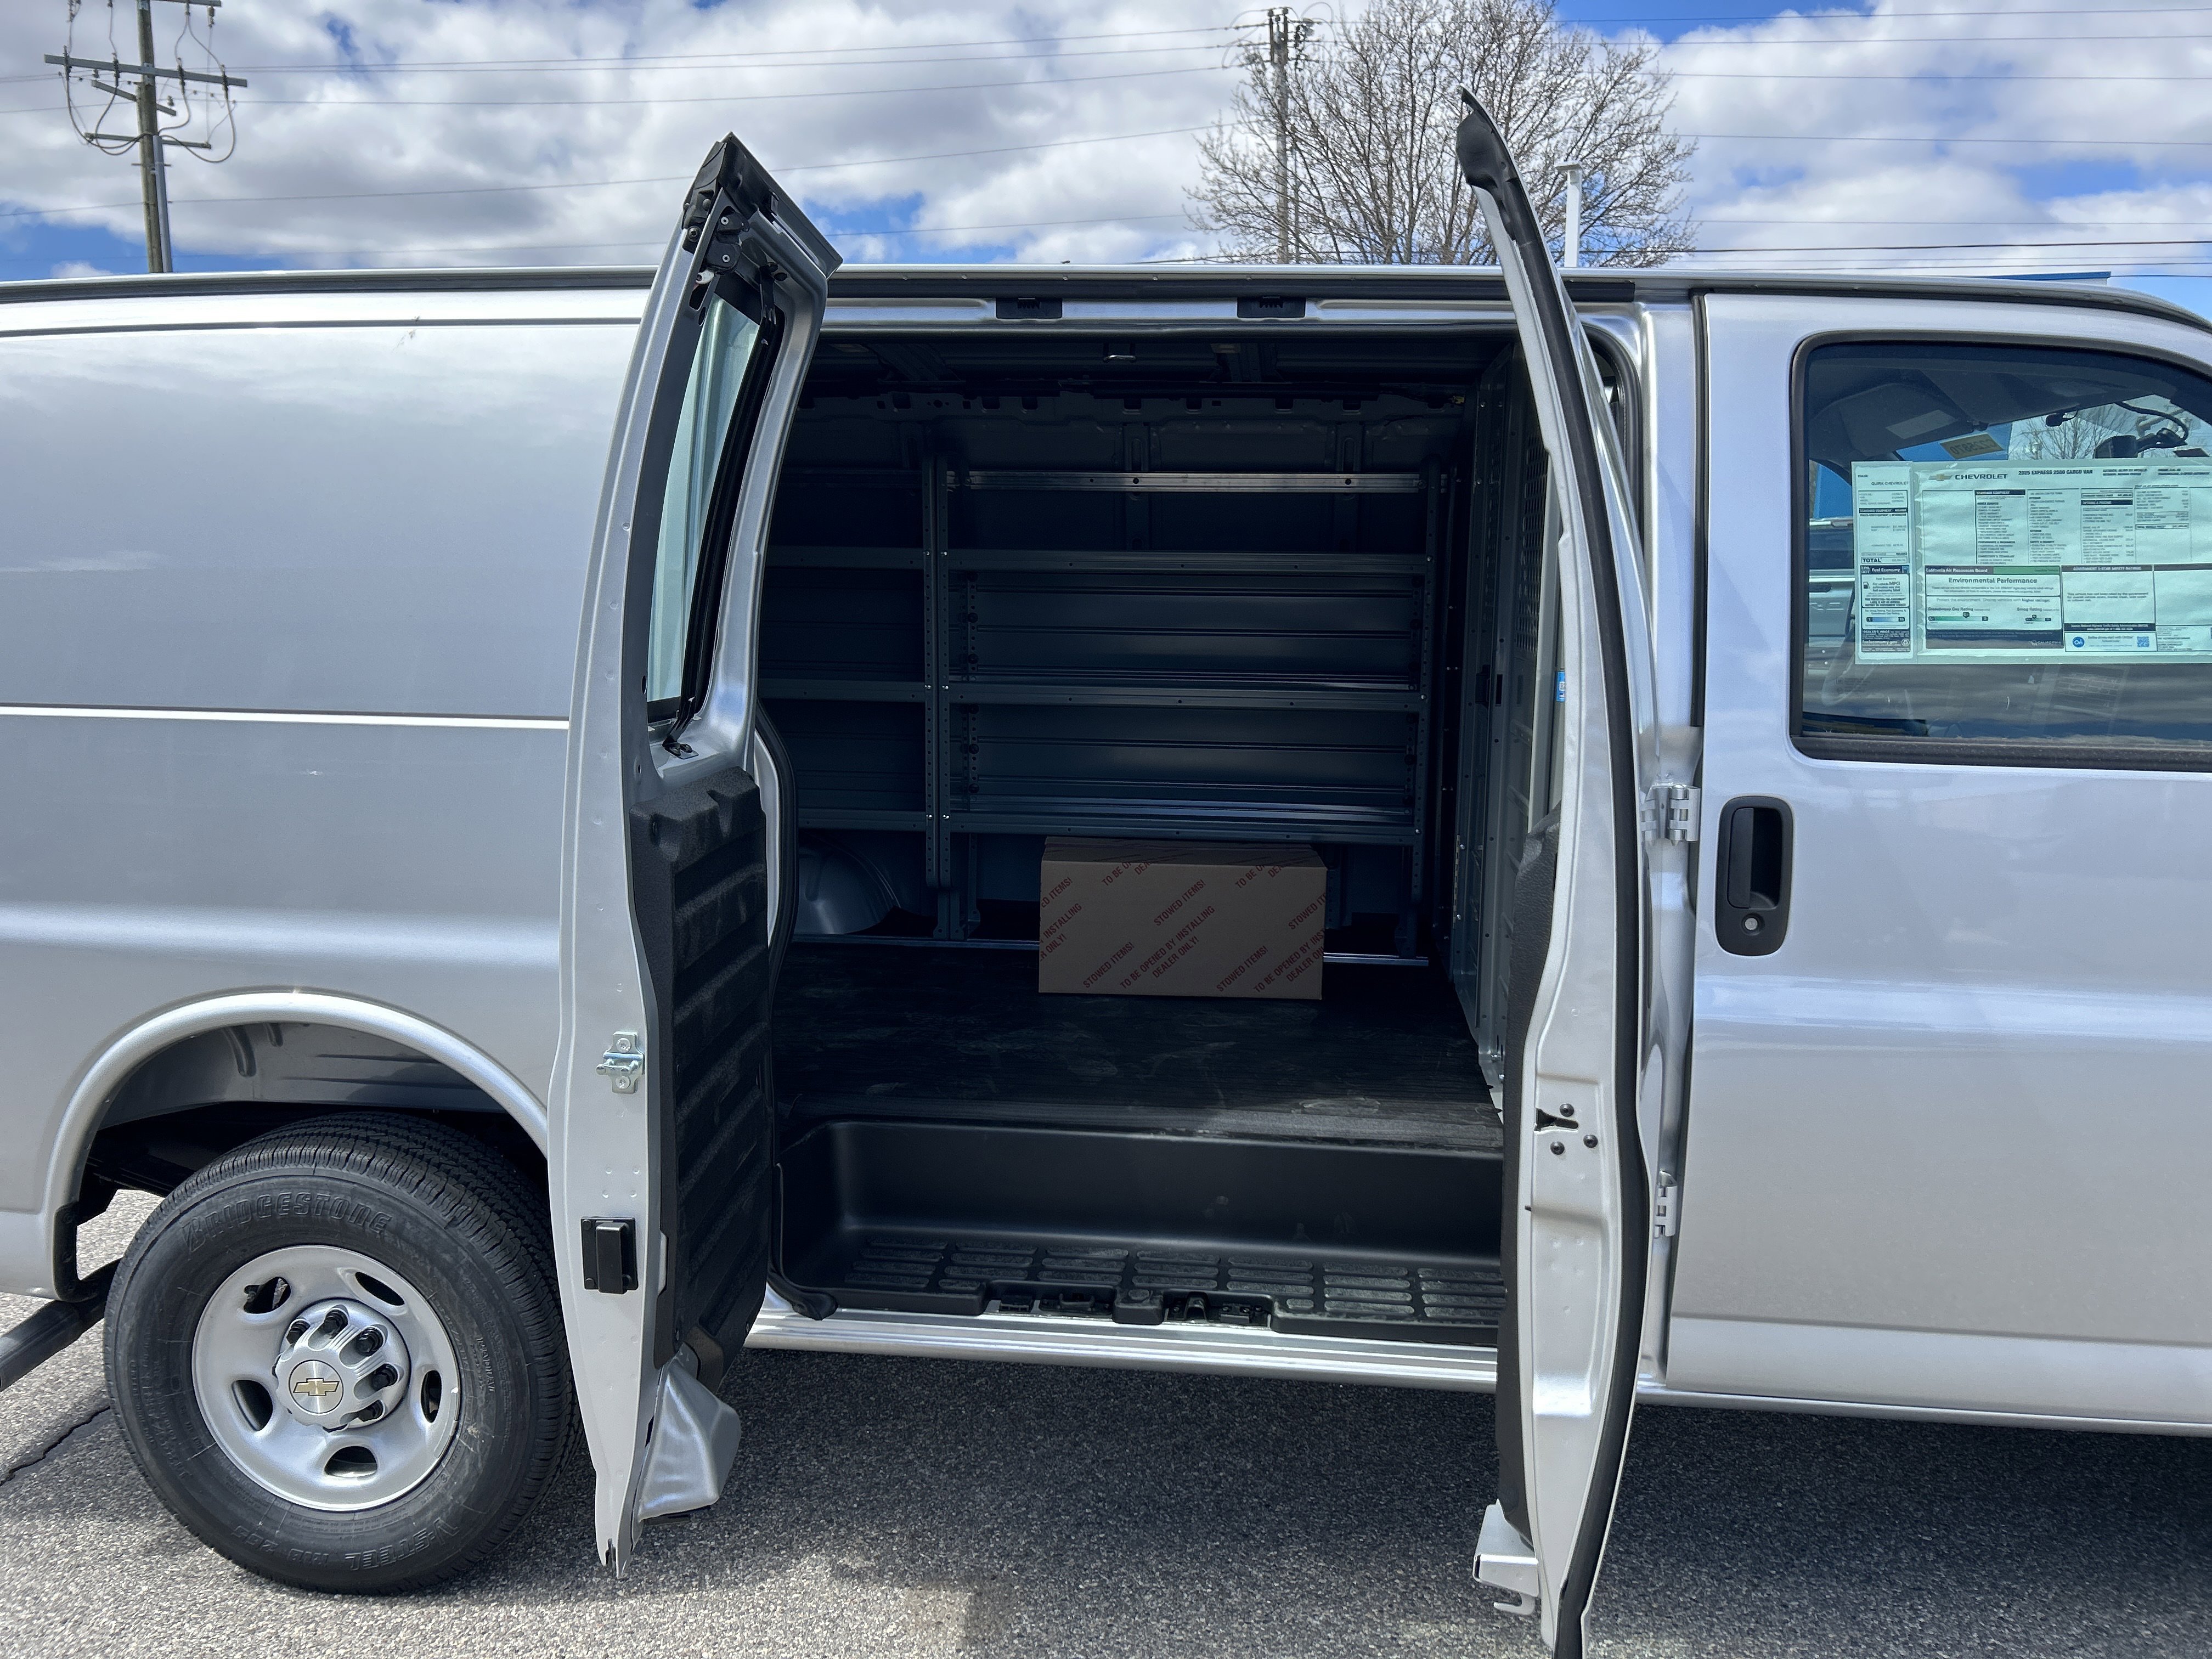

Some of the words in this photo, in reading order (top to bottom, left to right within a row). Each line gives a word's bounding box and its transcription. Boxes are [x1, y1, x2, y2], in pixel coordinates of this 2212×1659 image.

[1049, 877, 1073, 900] ITEMS!
[1102, 875, 1113, 886] TO
[1111, 866, 1123, 878] BE
[1235, 878, 1246, 888] TO
[1245, 869, 1257, 880] BE
[1043, 903, 1082, 939] INSTALLING
[1154, 899, 1183, 926] STOWED
[1182, 879, 1206, 902] ITEMS!
[1288, 903, 1318, 930] STOWED
[1046, 933, 1067, 953] ONLY!
[1120, 979, 1131, 989] TO
[1130, 969, 1141, 981] BE
[1140, 947, 1167, 972] OPENED
[1165, 938, 1176, 950] BY
[1176, 906, 1215, 941] INSTALLING
[1152, 953, 1180, 978] DEALER
[1178, 936, 1199, 956] ONLY!
[1083, 961, 1111, 988] STOWED
[1110, 941, 1135, 964] ITEMS!
[1216, 965, 1246, 992] STOWED
[1244, 945, 1268, 968] ITEMS!
[1254, 982, 1265, 992] TO
[1264, 973, 1276, 985] BE
[1274, 951, 1301, 976] OPENED
[1299, 942, 1311, 953] BY
[1286, 957, 1314, 982] DEALER
[182, 1192, 393, 1252] BRIDGESTONE
[344, 1516, 459, 1571] V-STEEL
